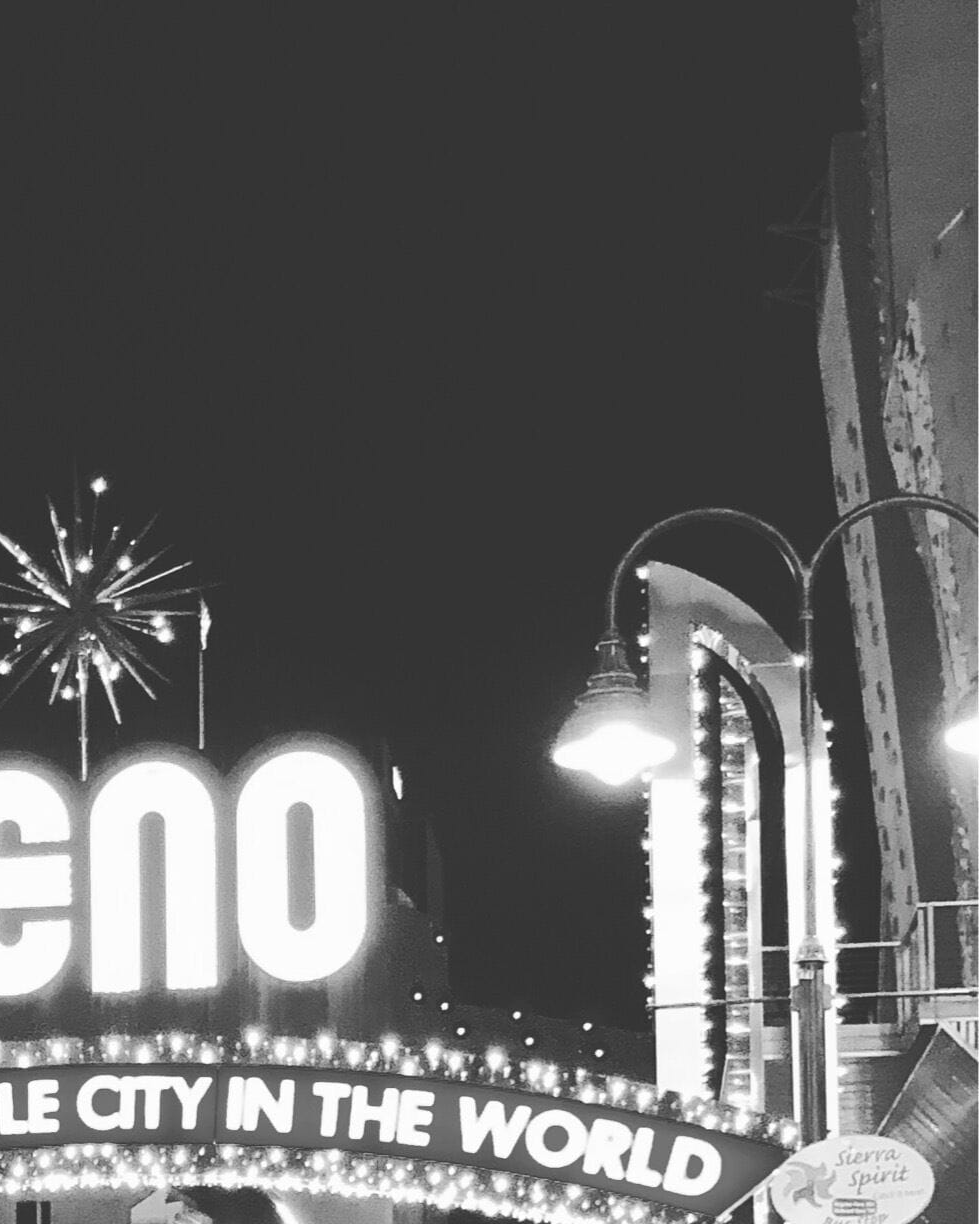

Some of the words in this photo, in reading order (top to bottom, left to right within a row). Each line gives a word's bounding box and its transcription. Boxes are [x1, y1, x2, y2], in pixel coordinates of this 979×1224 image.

[76, 1075, 213, 1131] CITY
[226, 1076, 295, 1133] IN
[312, 1081, 436, 1147] THE
[459, 1096, 722, 1196] WORLD
[835, 1145, 902, 1167] Sierra
[847, 1163, 911, 1196] Spirit
